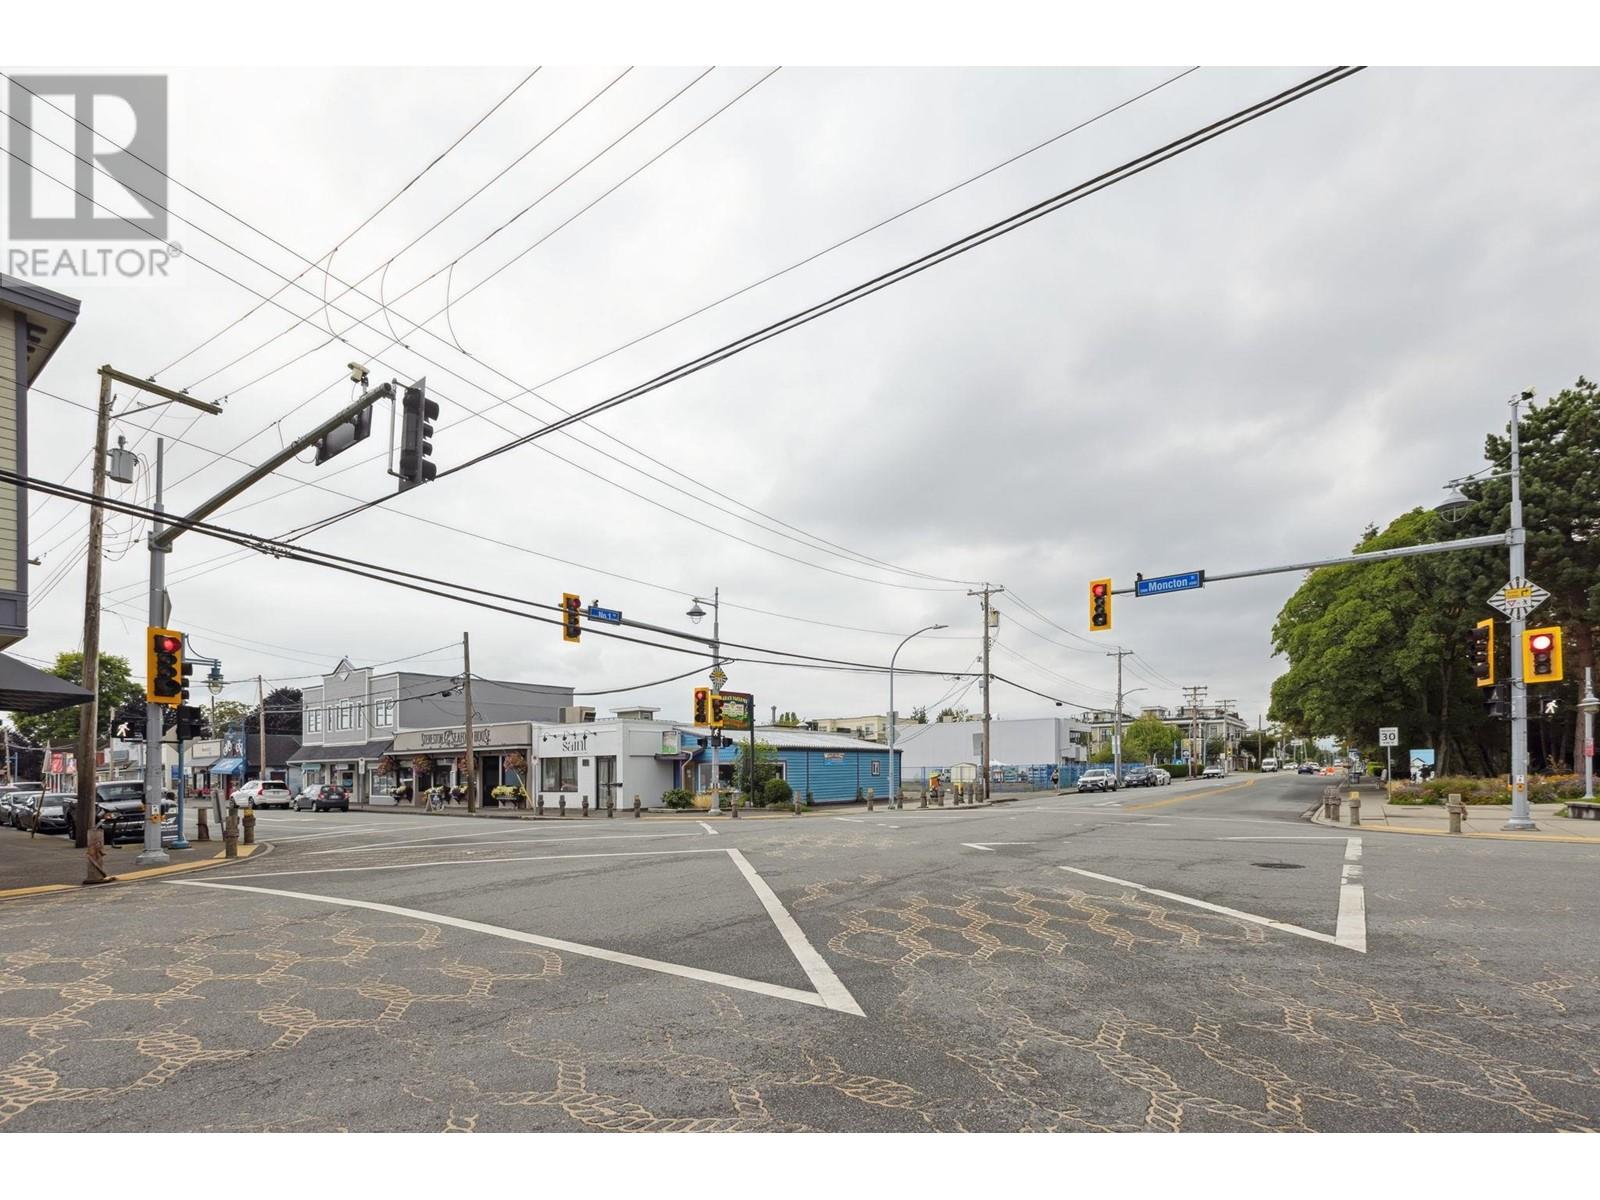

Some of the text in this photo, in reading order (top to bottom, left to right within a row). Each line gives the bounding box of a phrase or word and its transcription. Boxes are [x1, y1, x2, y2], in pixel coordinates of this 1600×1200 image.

[1148, 579, 1188, 591] Moncton
[1381, 732, 1396, 741] 30
[562, 736, 588, 751] saint
